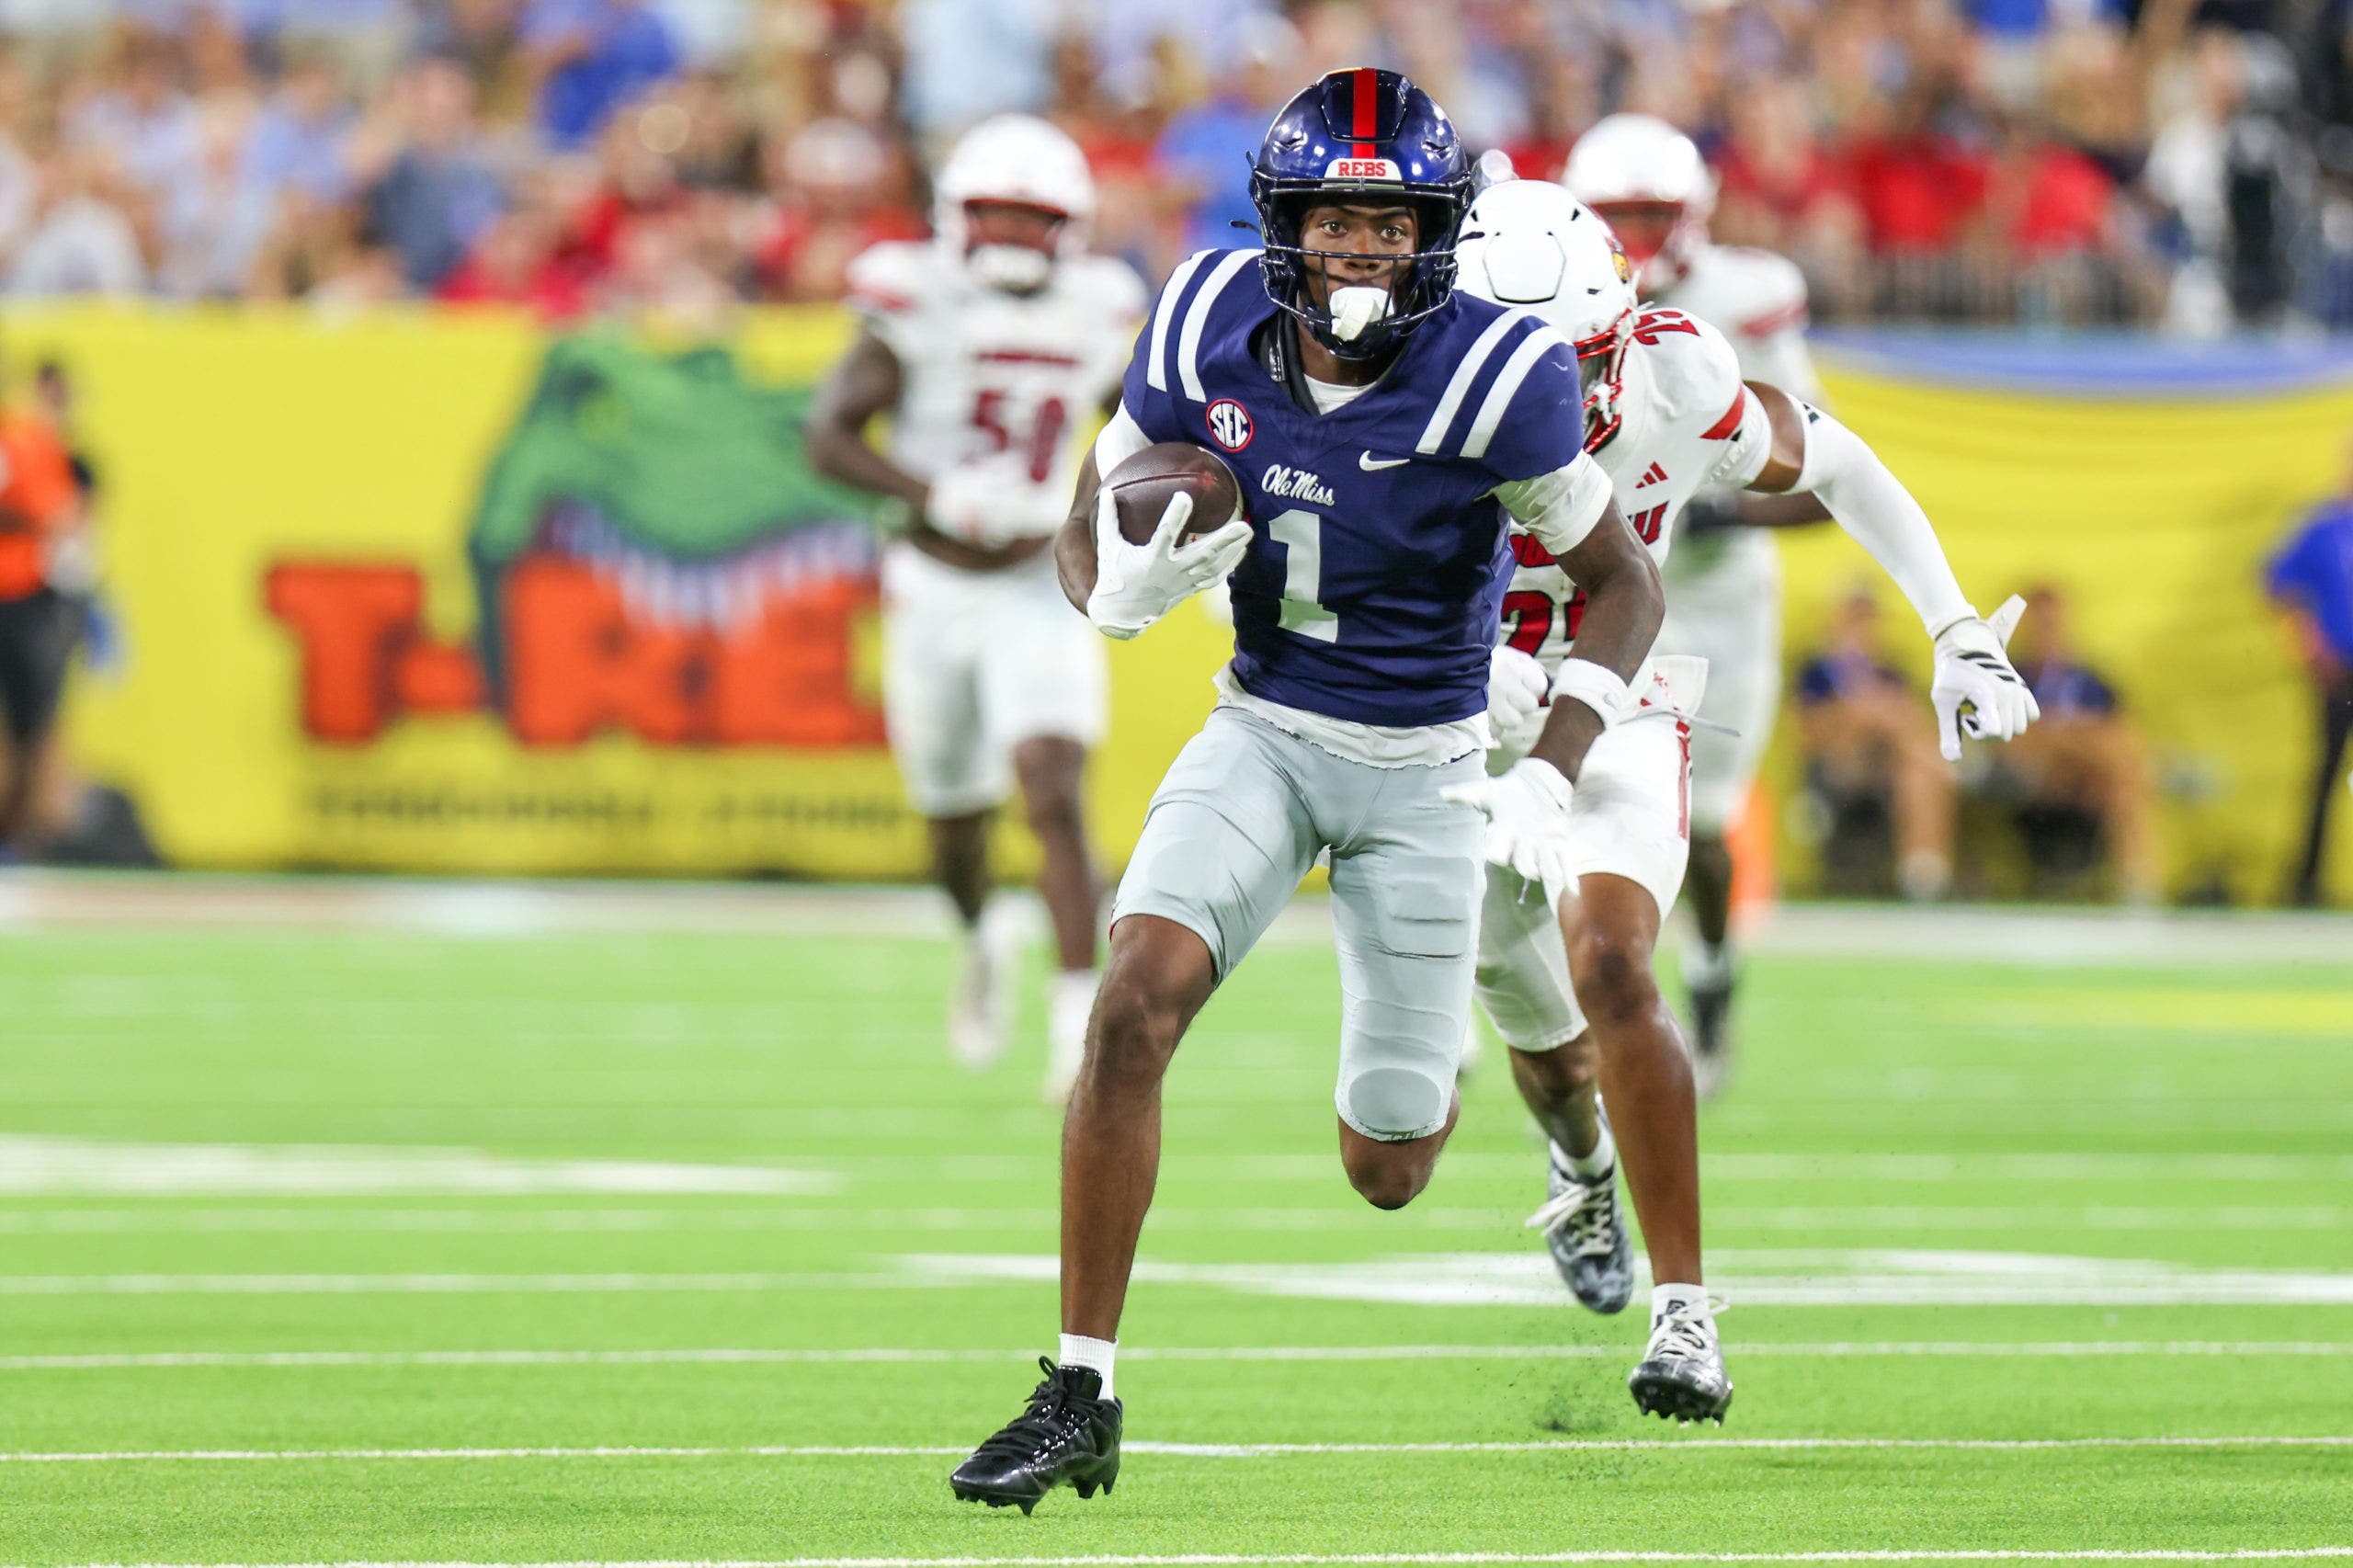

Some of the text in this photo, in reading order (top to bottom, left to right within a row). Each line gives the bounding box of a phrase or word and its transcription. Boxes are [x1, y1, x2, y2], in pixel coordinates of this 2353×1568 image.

[1337, 162, 1387, 177] REBS
[1210, 403, 1251, 449] SEC
[1261, 463, 1336, 507] Ole Miss
[1268, 508, 1339, 643] 1
[265, 559, 886, 748] T-RE
